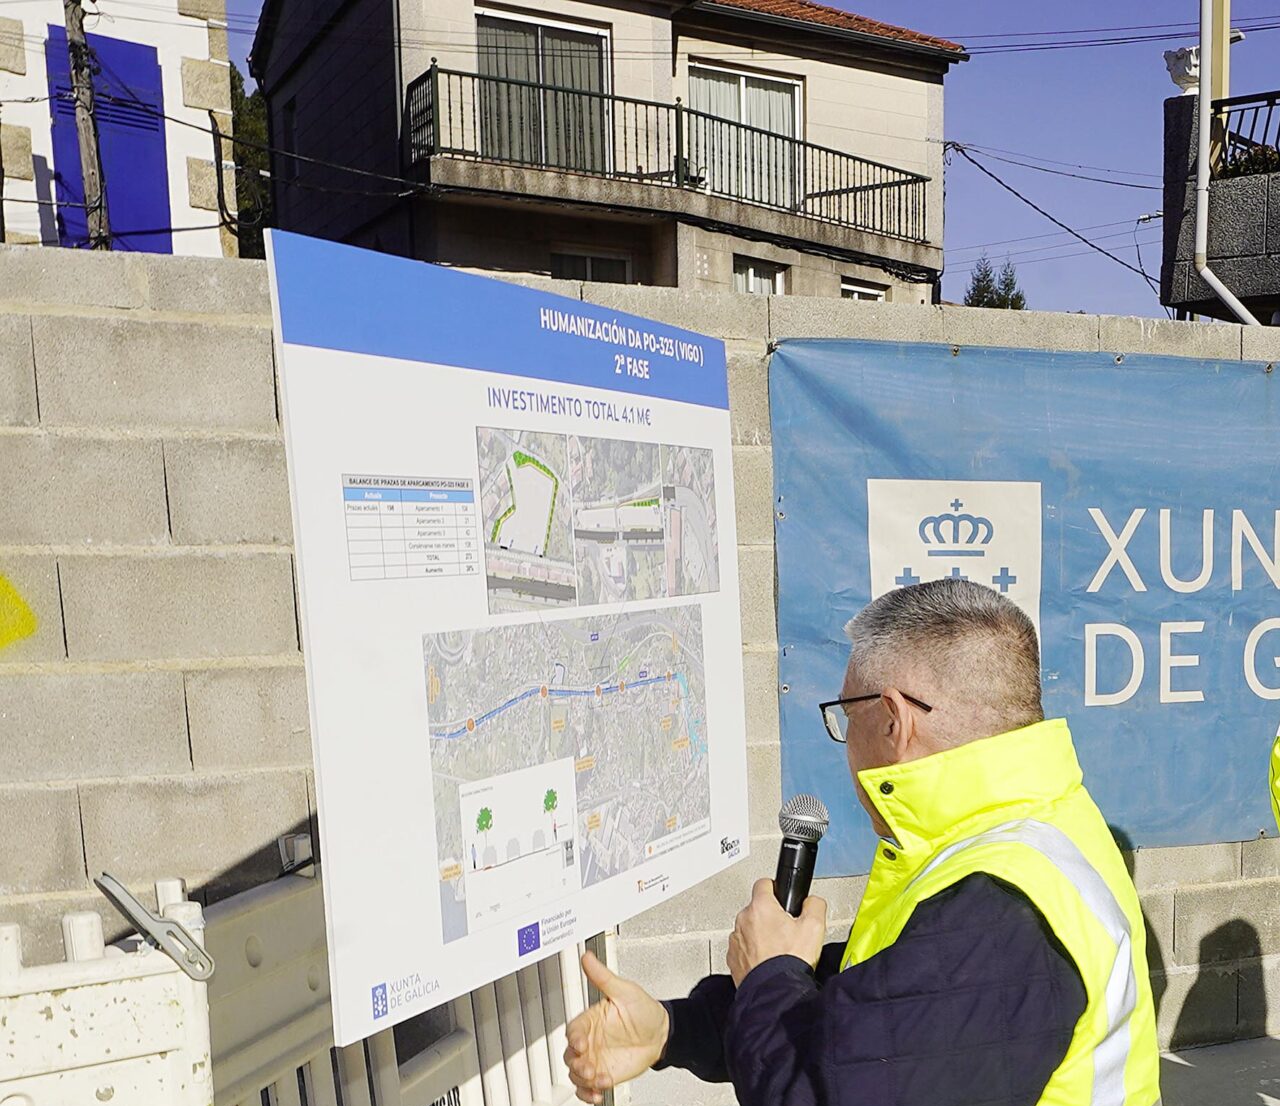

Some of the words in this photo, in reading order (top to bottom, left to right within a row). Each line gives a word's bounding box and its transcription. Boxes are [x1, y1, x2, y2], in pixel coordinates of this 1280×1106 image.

[540, 307, 627, 346] HUMANIZACIÓN
[628, 330, 643, 350] DA
[643, 334, 675, 358] PO-323
[614, 354, 625, 374] 2ª
[626, 357, 650, 380] FASE
[487, 386, 582, 418] INVESTIMENTO
[585, 399, 620, 422] TOTAL
[621, 405, 636, 424] 4.1
[637, 408, 652, 426] M€
[349, 478, 372, 486] BALANCE
[373, 478, 380, 486] DE
[381, 479, 399, 487] PRAZAS
[1084, 620, 1205, 708] DE
[389, 973, 421, 995] XUNTA
[390, 994, 403, 1009] DE
[404, 979, 440, 1003] GALICIA
